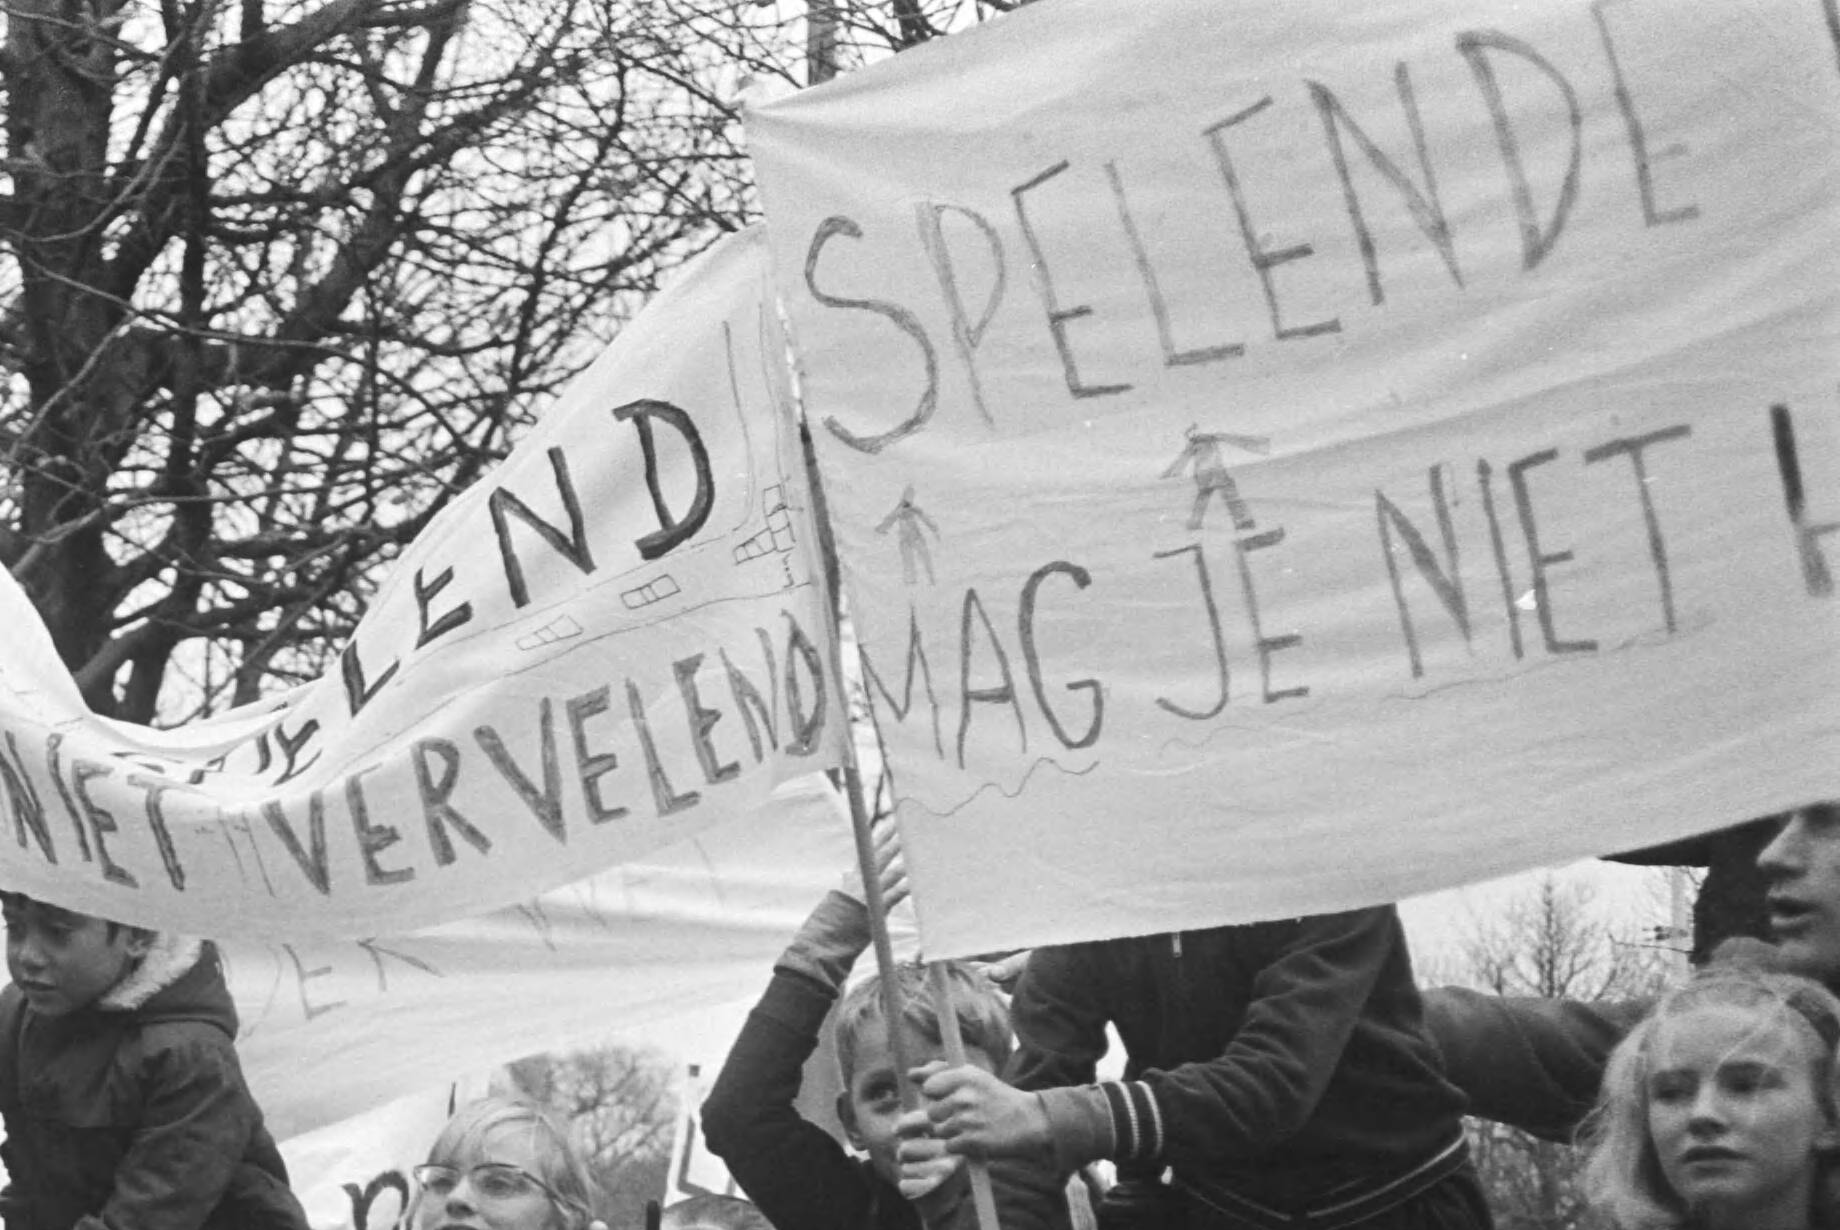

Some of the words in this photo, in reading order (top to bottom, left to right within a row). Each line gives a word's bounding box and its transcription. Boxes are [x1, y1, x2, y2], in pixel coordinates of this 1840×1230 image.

[804, 2, 1700, 454] SPELENDE
[262, 608, 827, 896] VERVELEND
[857, 560, 1104, 790] MAG
[1153, 526, 1310, 720] JE
[1374, 423, 1692, 678] NIET
